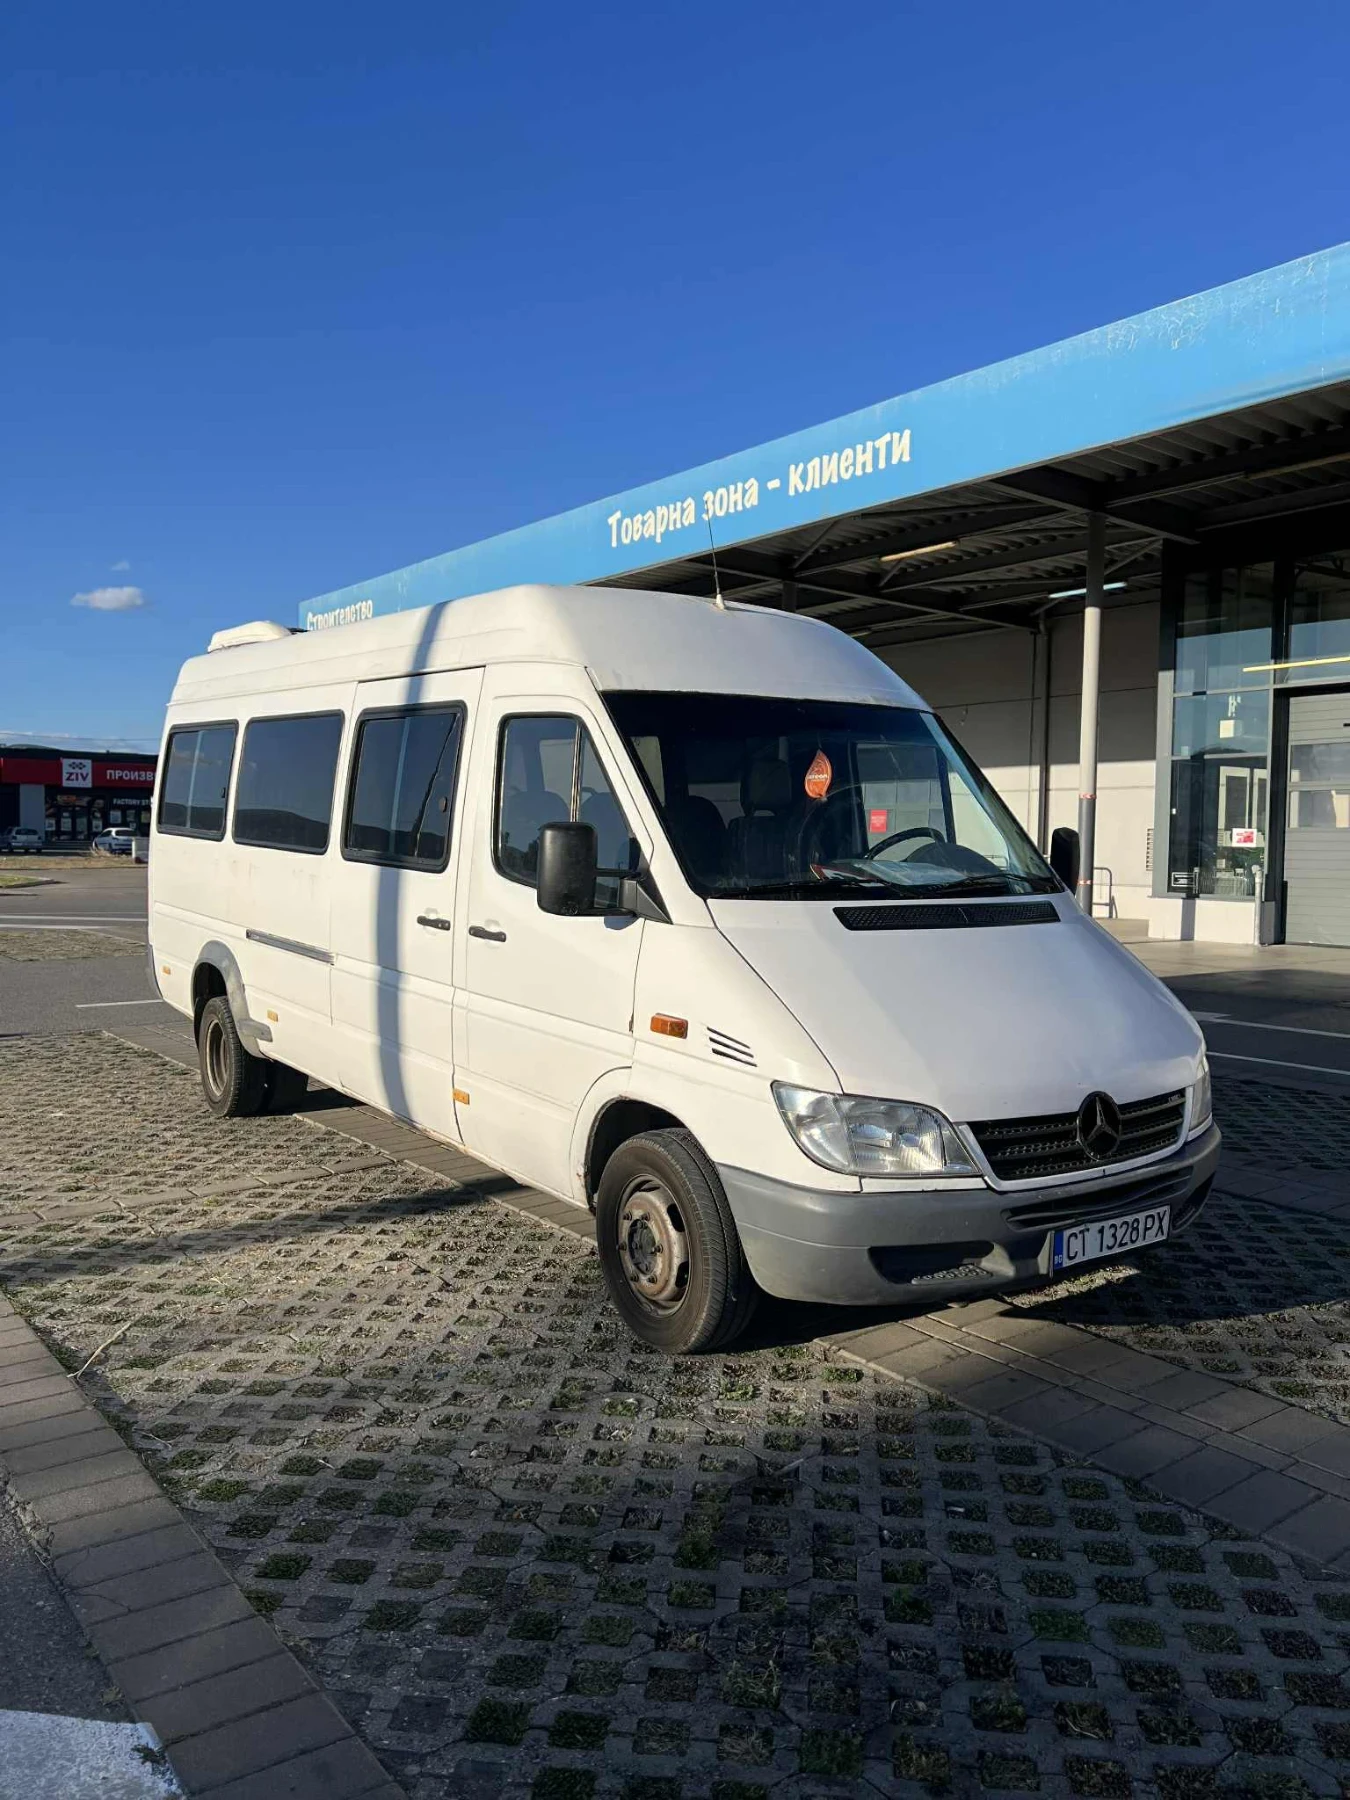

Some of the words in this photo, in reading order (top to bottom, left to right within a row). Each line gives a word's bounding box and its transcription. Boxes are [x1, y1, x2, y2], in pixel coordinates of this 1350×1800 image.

[607, 497, 696, 548] Товарна
[701, 477, 759, 521] зона
[788, 429, 911, 496] клиенти
[306, 599, 373, 631] Строителство
[65, 771, 89, 782] ZIV
[106, 769, 156, 781] ПРОИЗВ
[1067, 1227, 1090, 1261] CT
[1098, 1218, 1140, 1252] 1328
[1143, 1210, 1166, 1240] PX
[1054, 1254, 1063, 1265] BG
